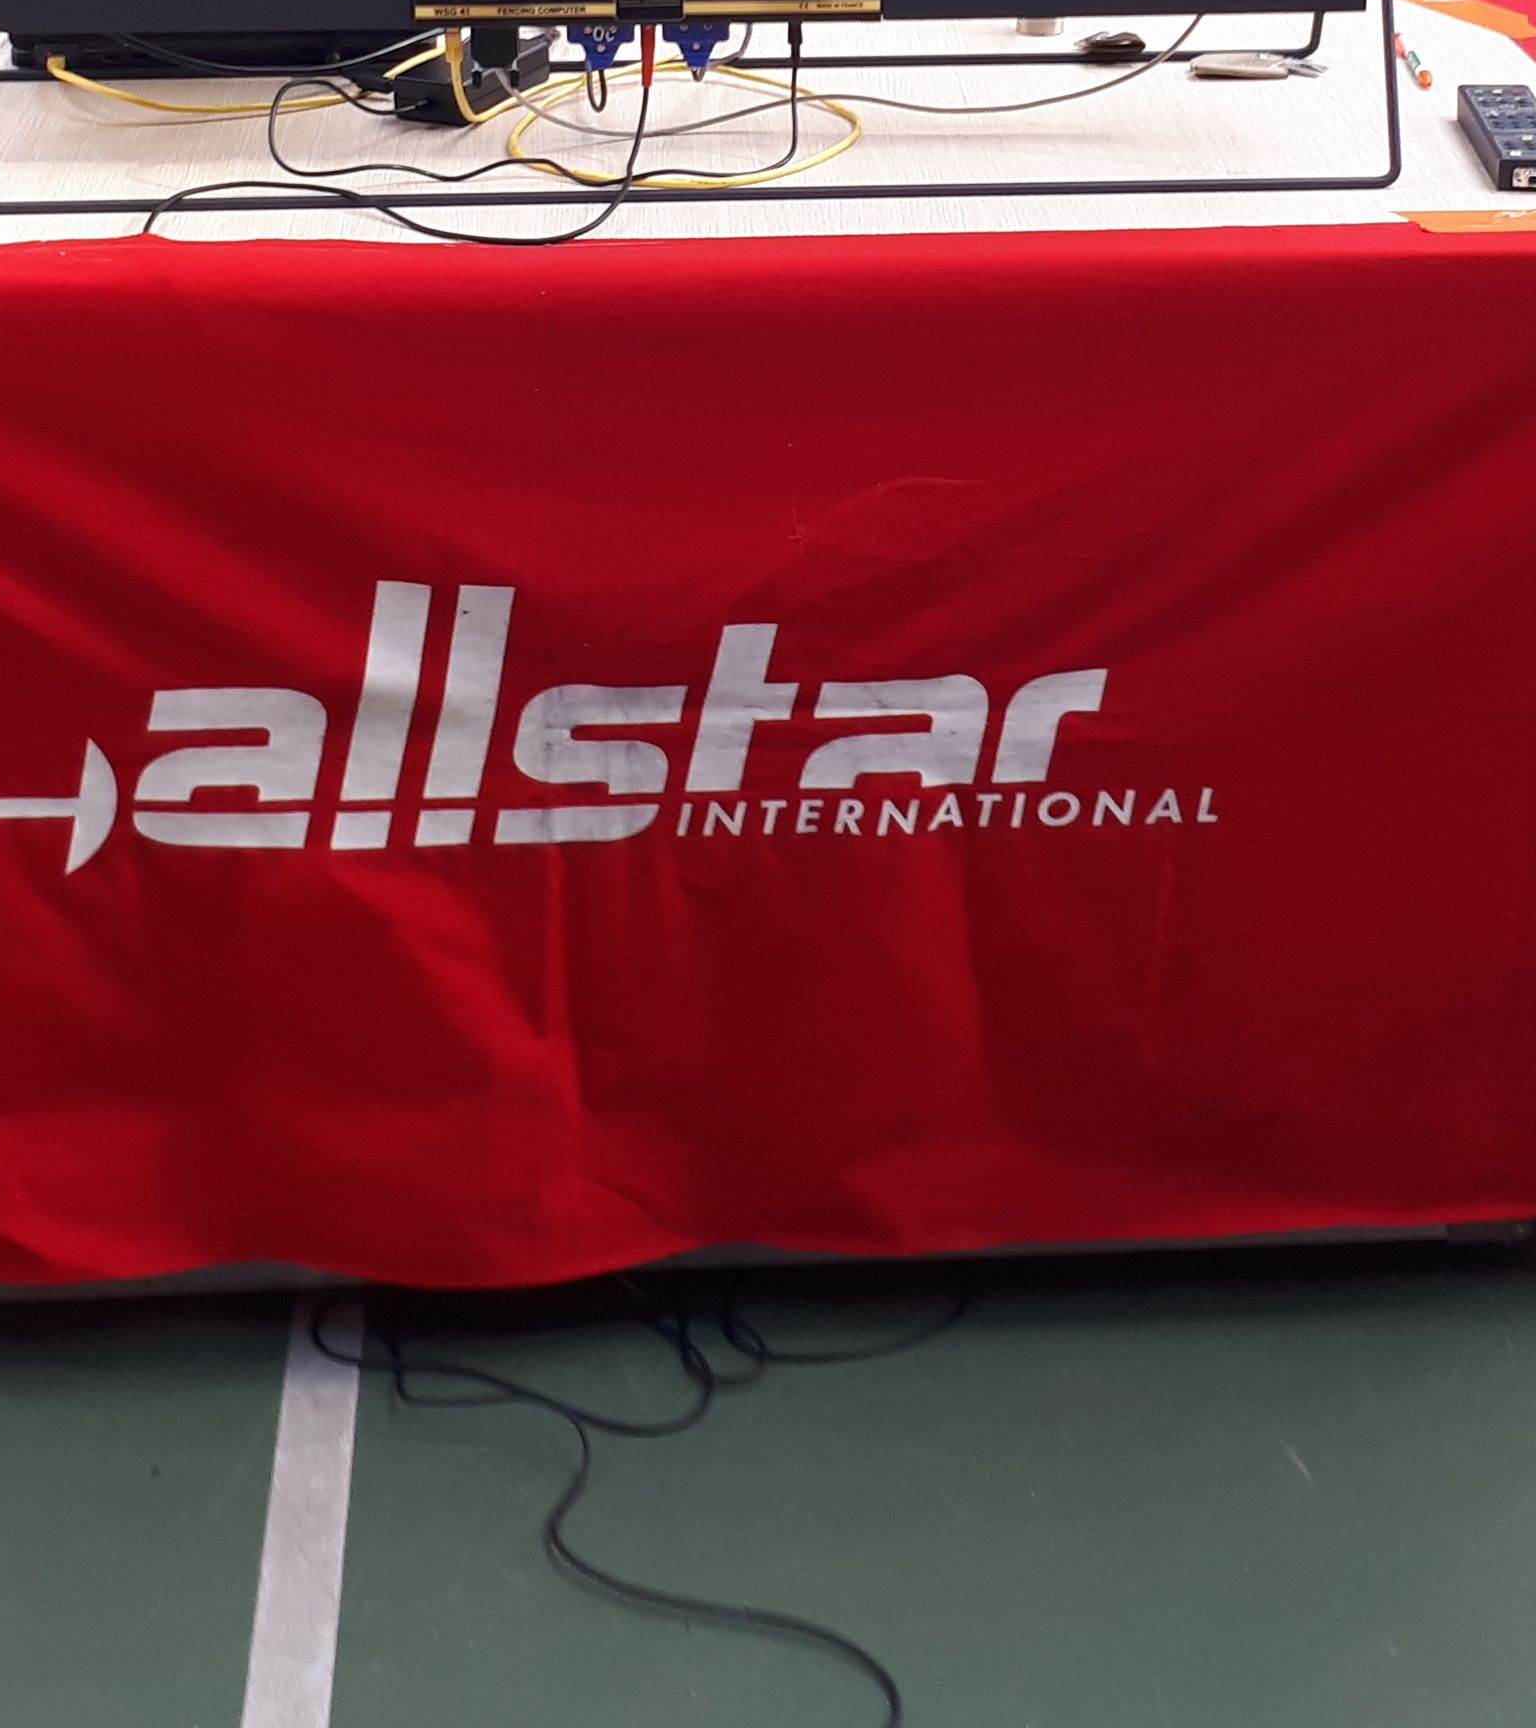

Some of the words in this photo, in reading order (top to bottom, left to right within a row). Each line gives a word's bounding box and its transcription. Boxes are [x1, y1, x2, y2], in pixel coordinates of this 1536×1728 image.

[496, 7, 534, 16] FENCING
[537, 5, 586, 15] COMPUTER
[133, 580, 1109, 850] allstar
[676, 787, 1219, 838] INTERNATIONAL
